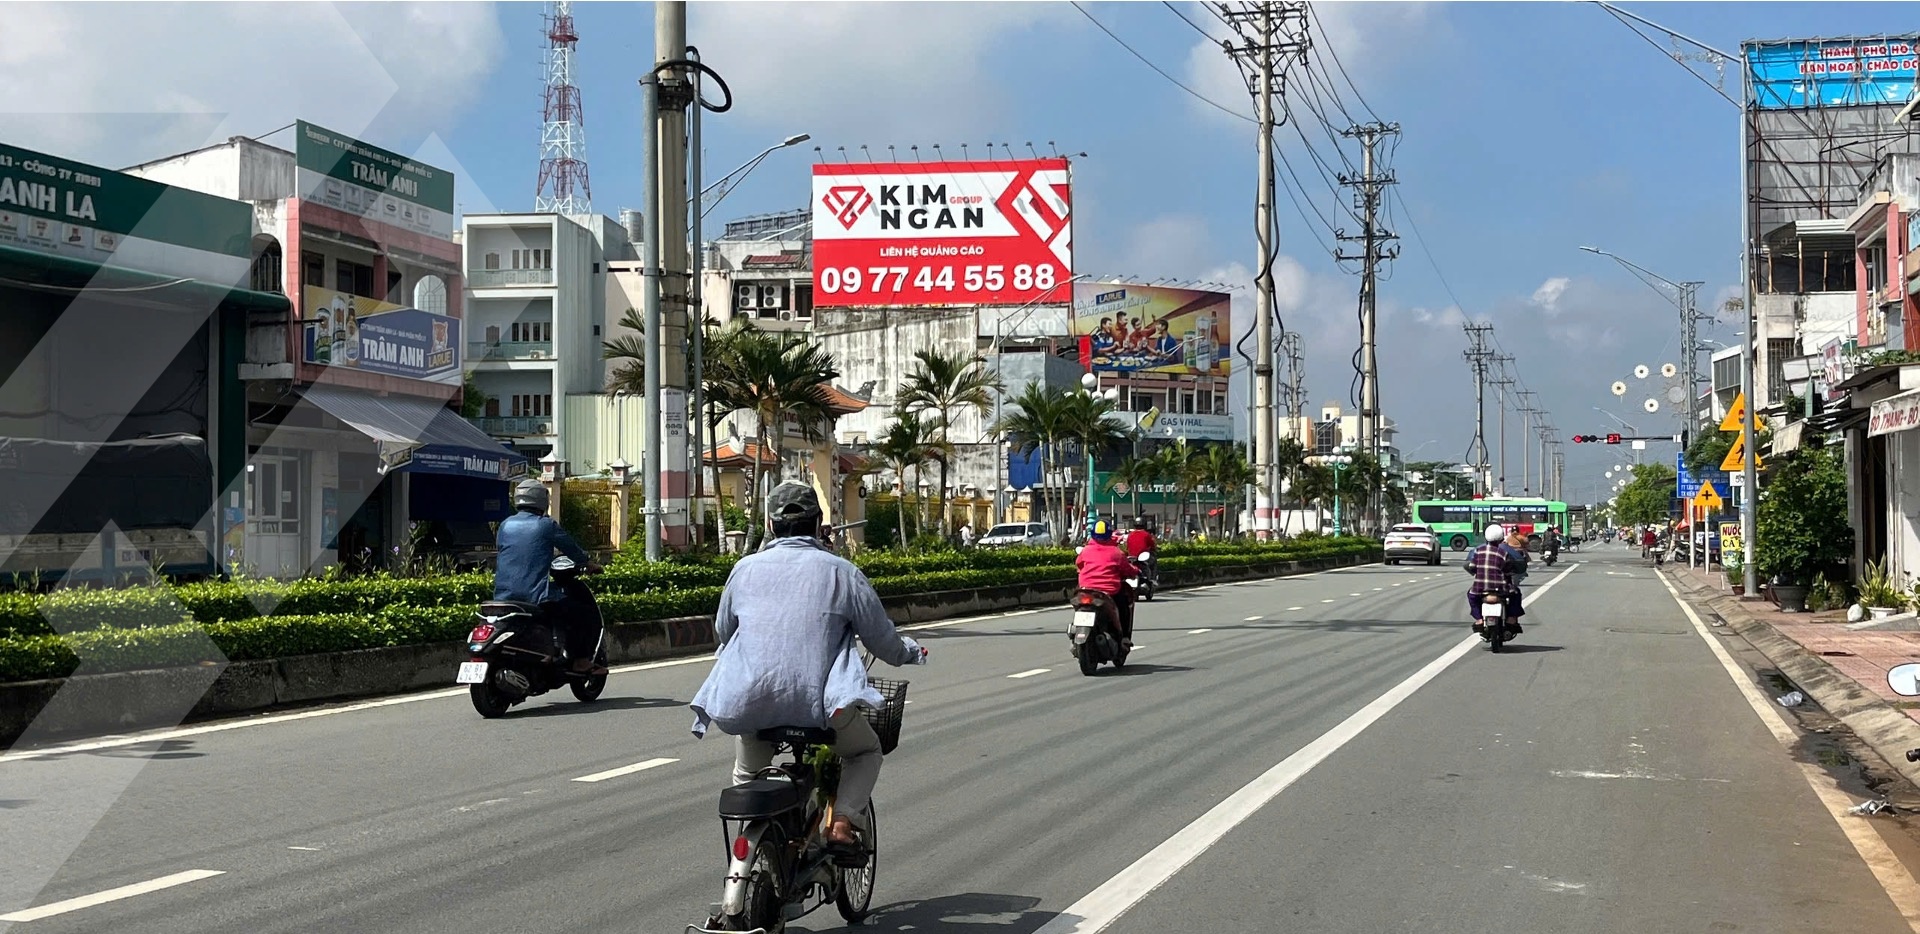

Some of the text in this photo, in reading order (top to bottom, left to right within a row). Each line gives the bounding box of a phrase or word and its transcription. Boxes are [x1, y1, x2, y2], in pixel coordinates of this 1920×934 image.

[351, 161, 388, 188] TRÂM
[0, 177, 96, 221] ANH LA
[880, 184, 982, 206] KIM GROUP
[880, 207, 984, 230] NGAN
[880, 243, 984, 258] LIÊN HỆ QUẢNG CÁO
[820, 263, 1055, 293] 09 77 44 55 88
[1099, 290, 1123, 304] LARUE
[363, 336, 424, 368] TRÂM ANH
[428, 352, 451, 368] LARUE
[1160, 417, 1178, 426] GAS
[464, 455, 483, 473] TRÂM
[484, 460, 499, 474] ANH
